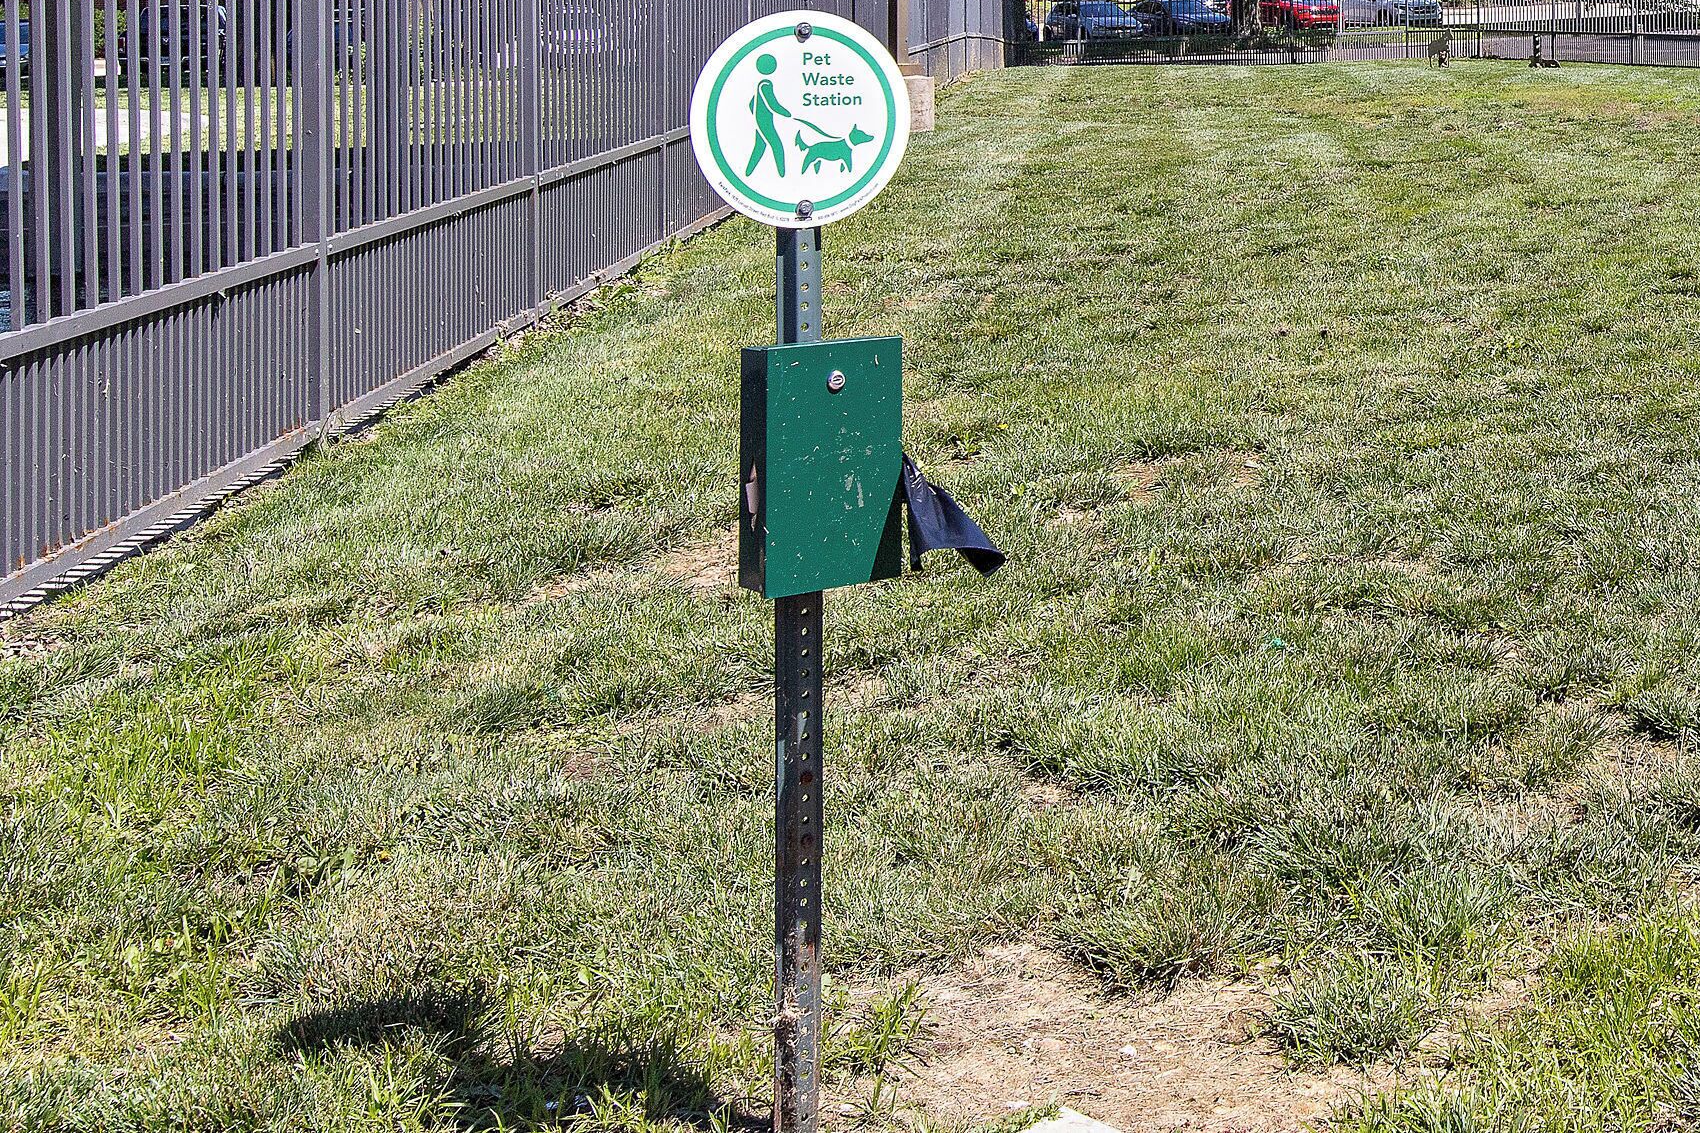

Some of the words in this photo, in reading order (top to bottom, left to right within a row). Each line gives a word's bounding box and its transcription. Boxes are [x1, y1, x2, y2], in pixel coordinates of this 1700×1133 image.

[803, 52, 831, 66] Pet
[802, 72, 855, 86] Waste
[802, 92, 862, 106] Station
